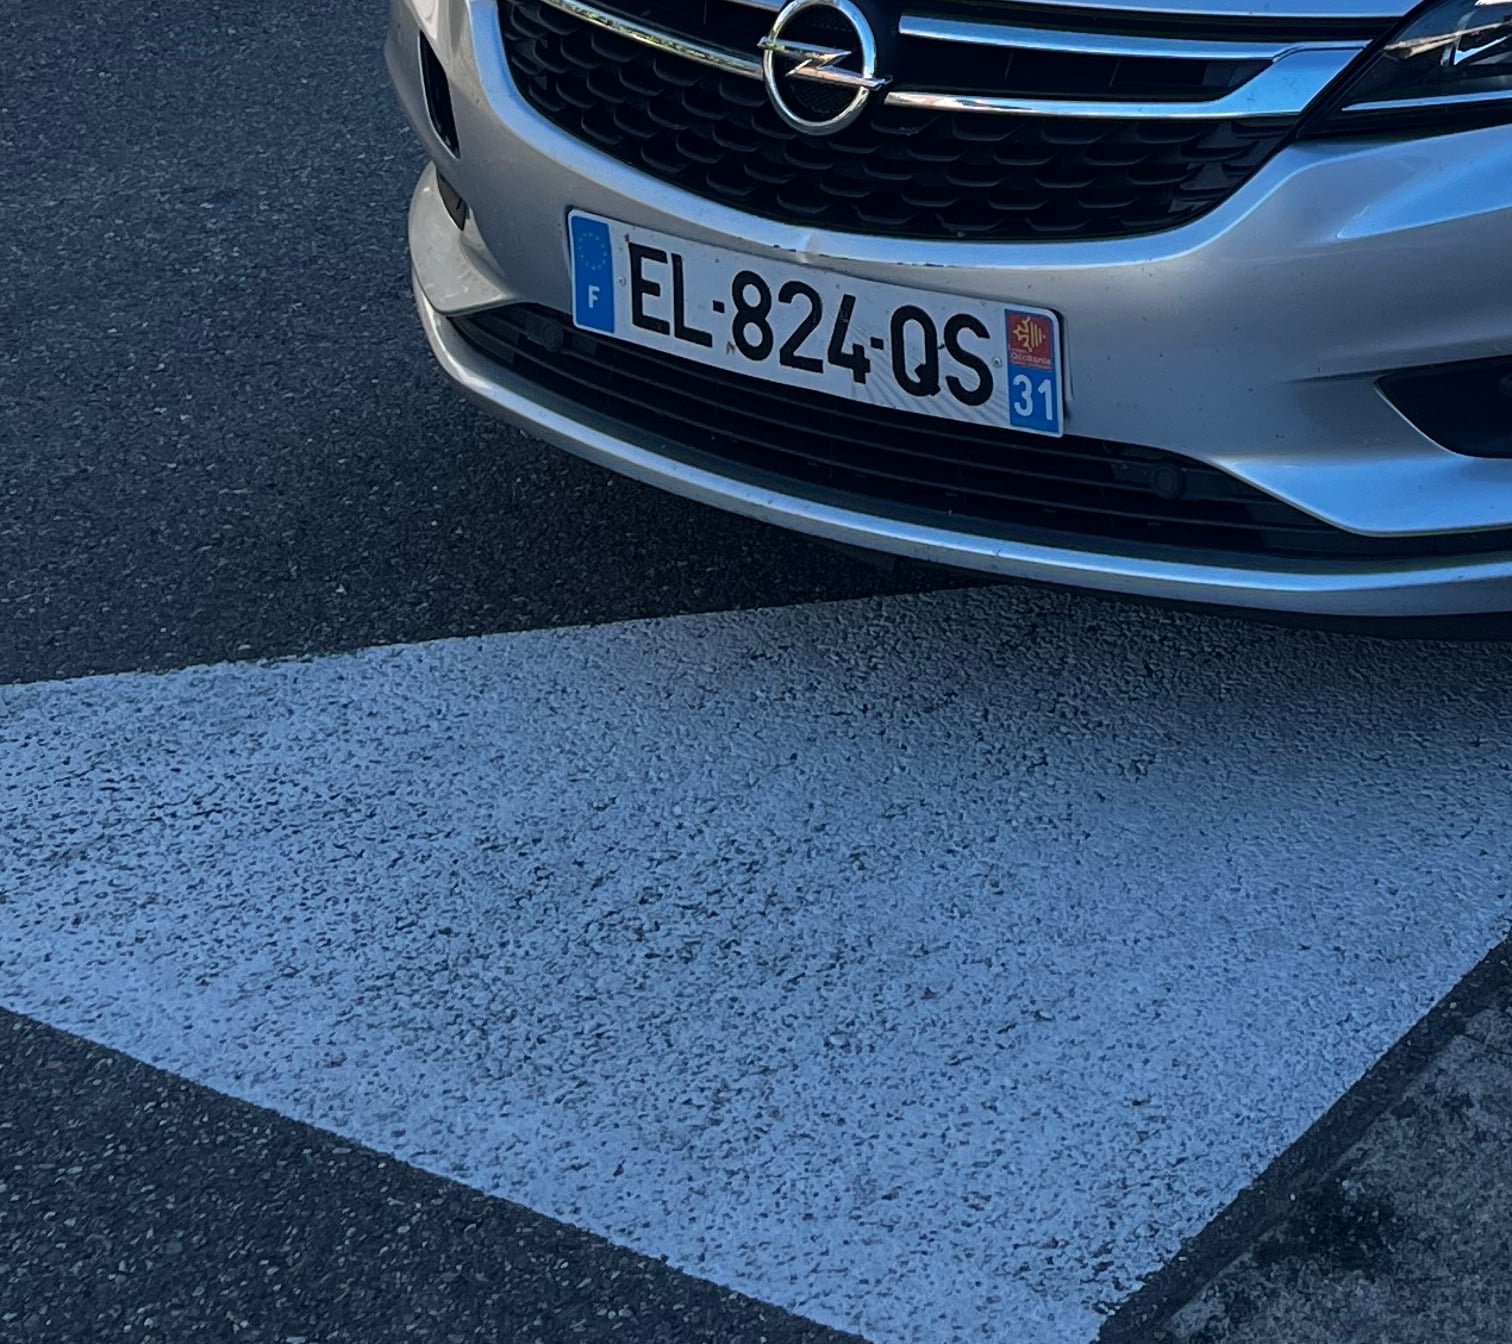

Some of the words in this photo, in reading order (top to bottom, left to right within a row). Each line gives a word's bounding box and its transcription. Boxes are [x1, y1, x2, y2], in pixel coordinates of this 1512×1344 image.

[588, 284, 600, 309] F
[628, 242, 994, 406] EL-824-QS
[1013, 374, 1053, 421] 31
